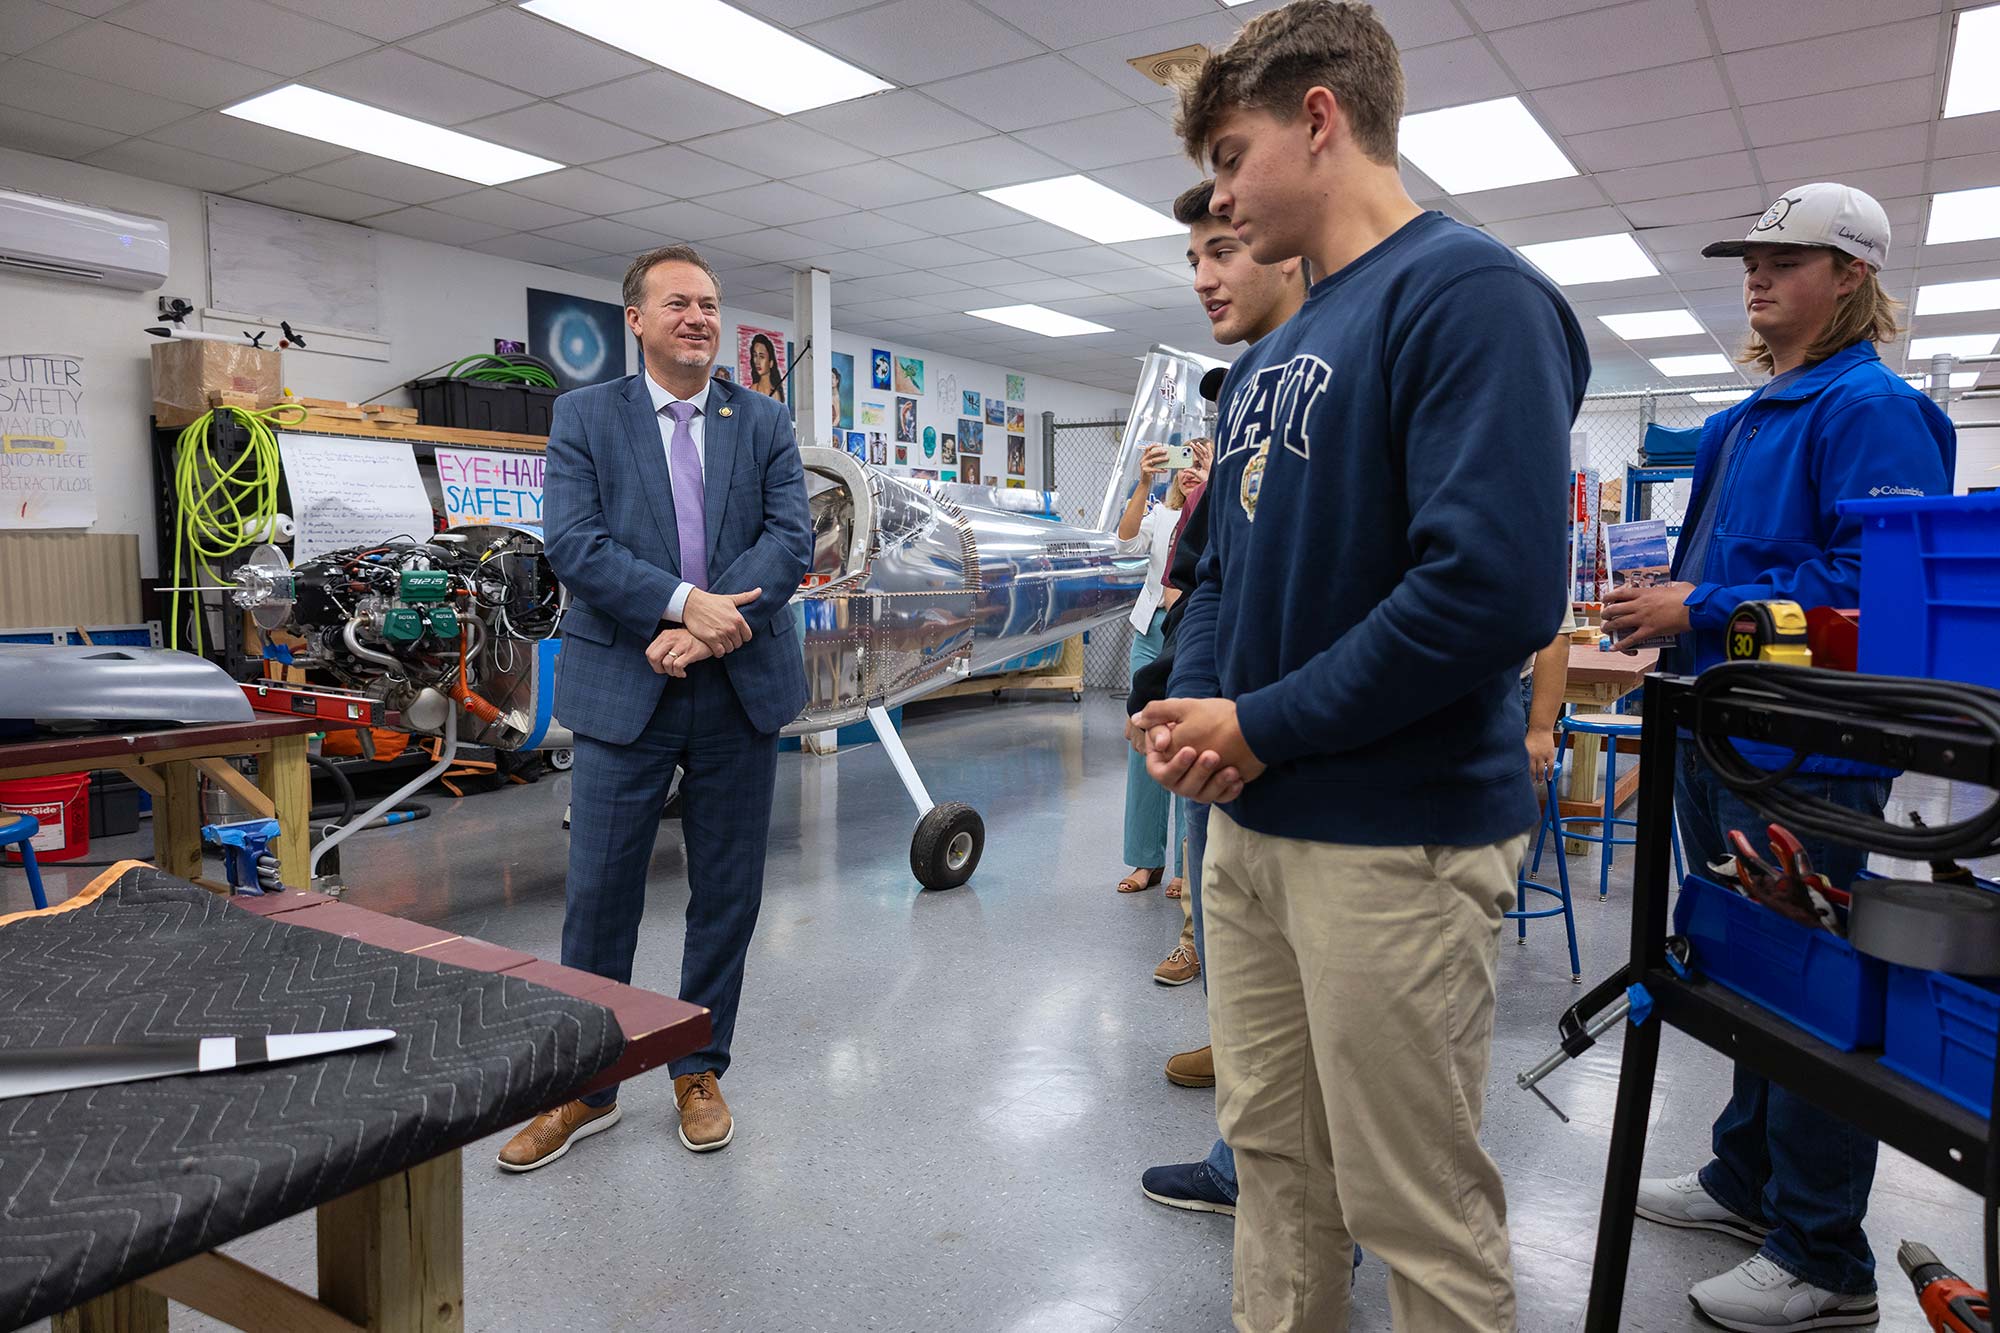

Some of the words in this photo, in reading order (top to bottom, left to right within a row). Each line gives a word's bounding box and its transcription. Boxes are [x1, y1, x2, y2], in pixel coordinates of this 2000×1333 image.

[35, 417, 87, 438] FROM
[447, 485, 544, 519] SAFETY
[1881, 486, 1925, 497] Columbia
[1734, 633, 1754, 657] 30
